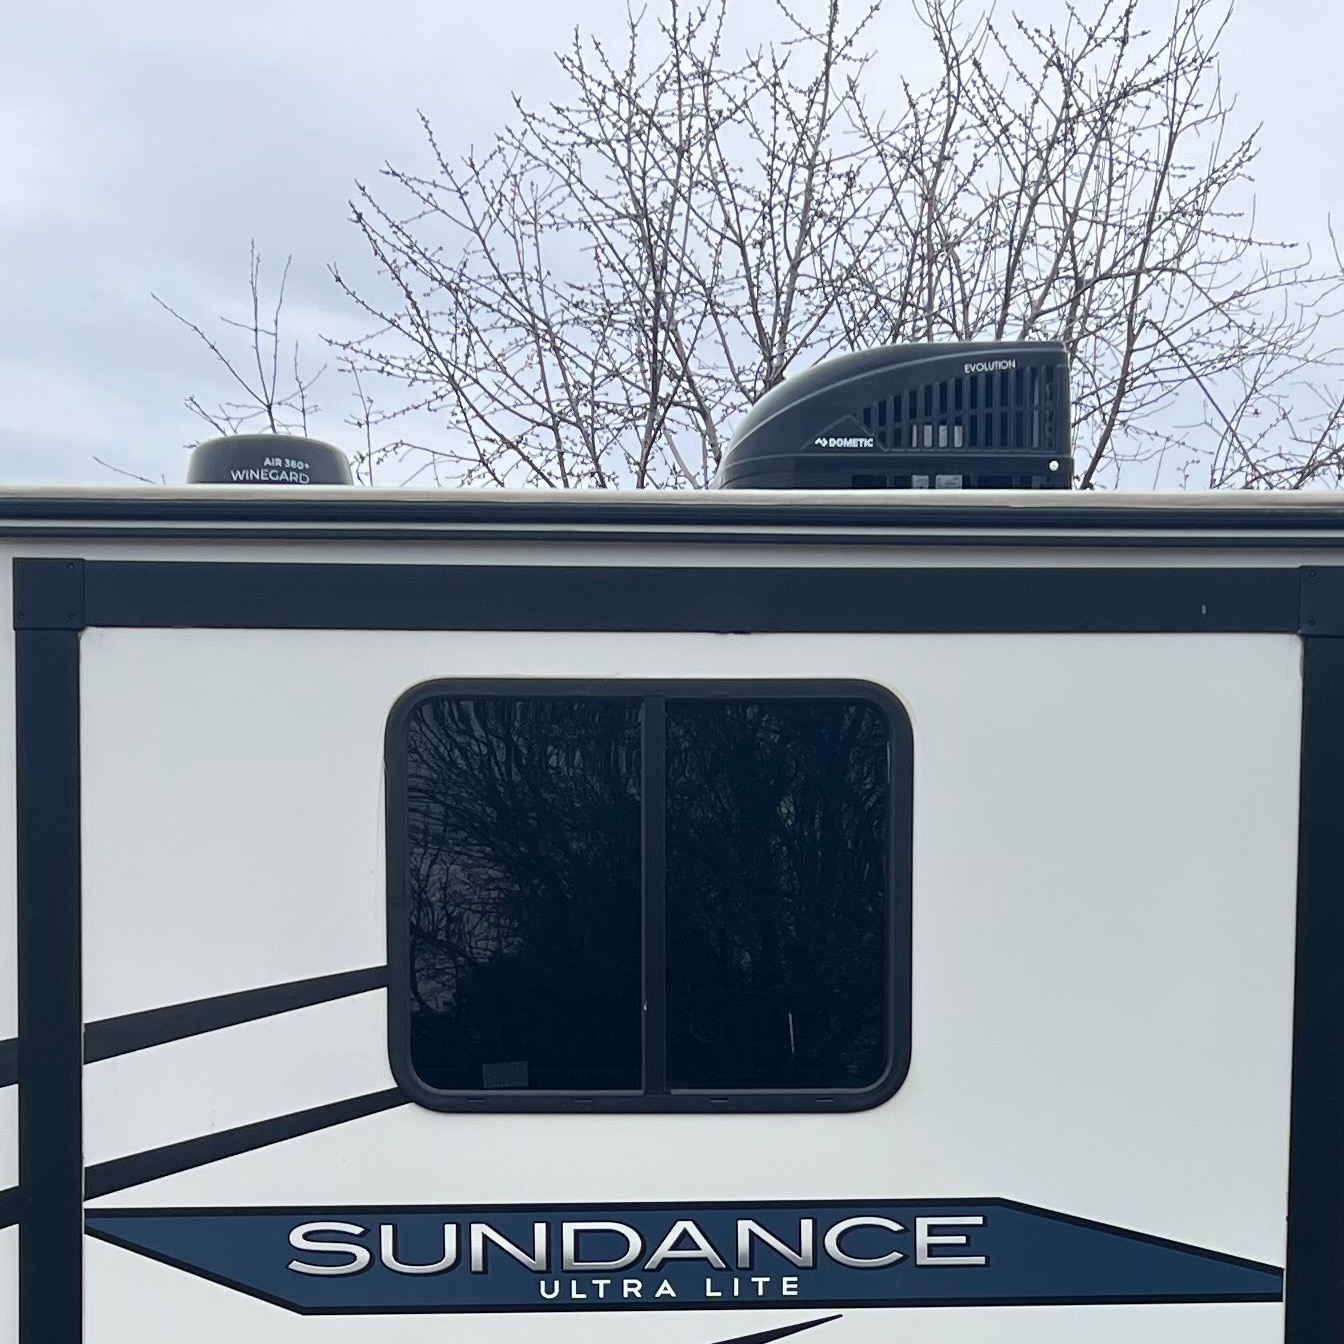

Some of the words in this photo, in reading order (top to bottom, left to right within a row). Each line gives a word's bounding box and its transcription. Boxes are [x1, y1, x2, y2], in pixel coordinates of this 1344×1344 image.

[964, 359, 1016, 374] EVOLUTION
[828, 437, 874, 448] DOMETIC
[263, 457, 283, 468] AIR
[230, 468, 310, 484] WINEGARD
[287, 1215, 989, 1277] SUNDANCE
[539, 1278, 677, 1300] ULTRA
[705, 1276, 799, 1297] LITE
